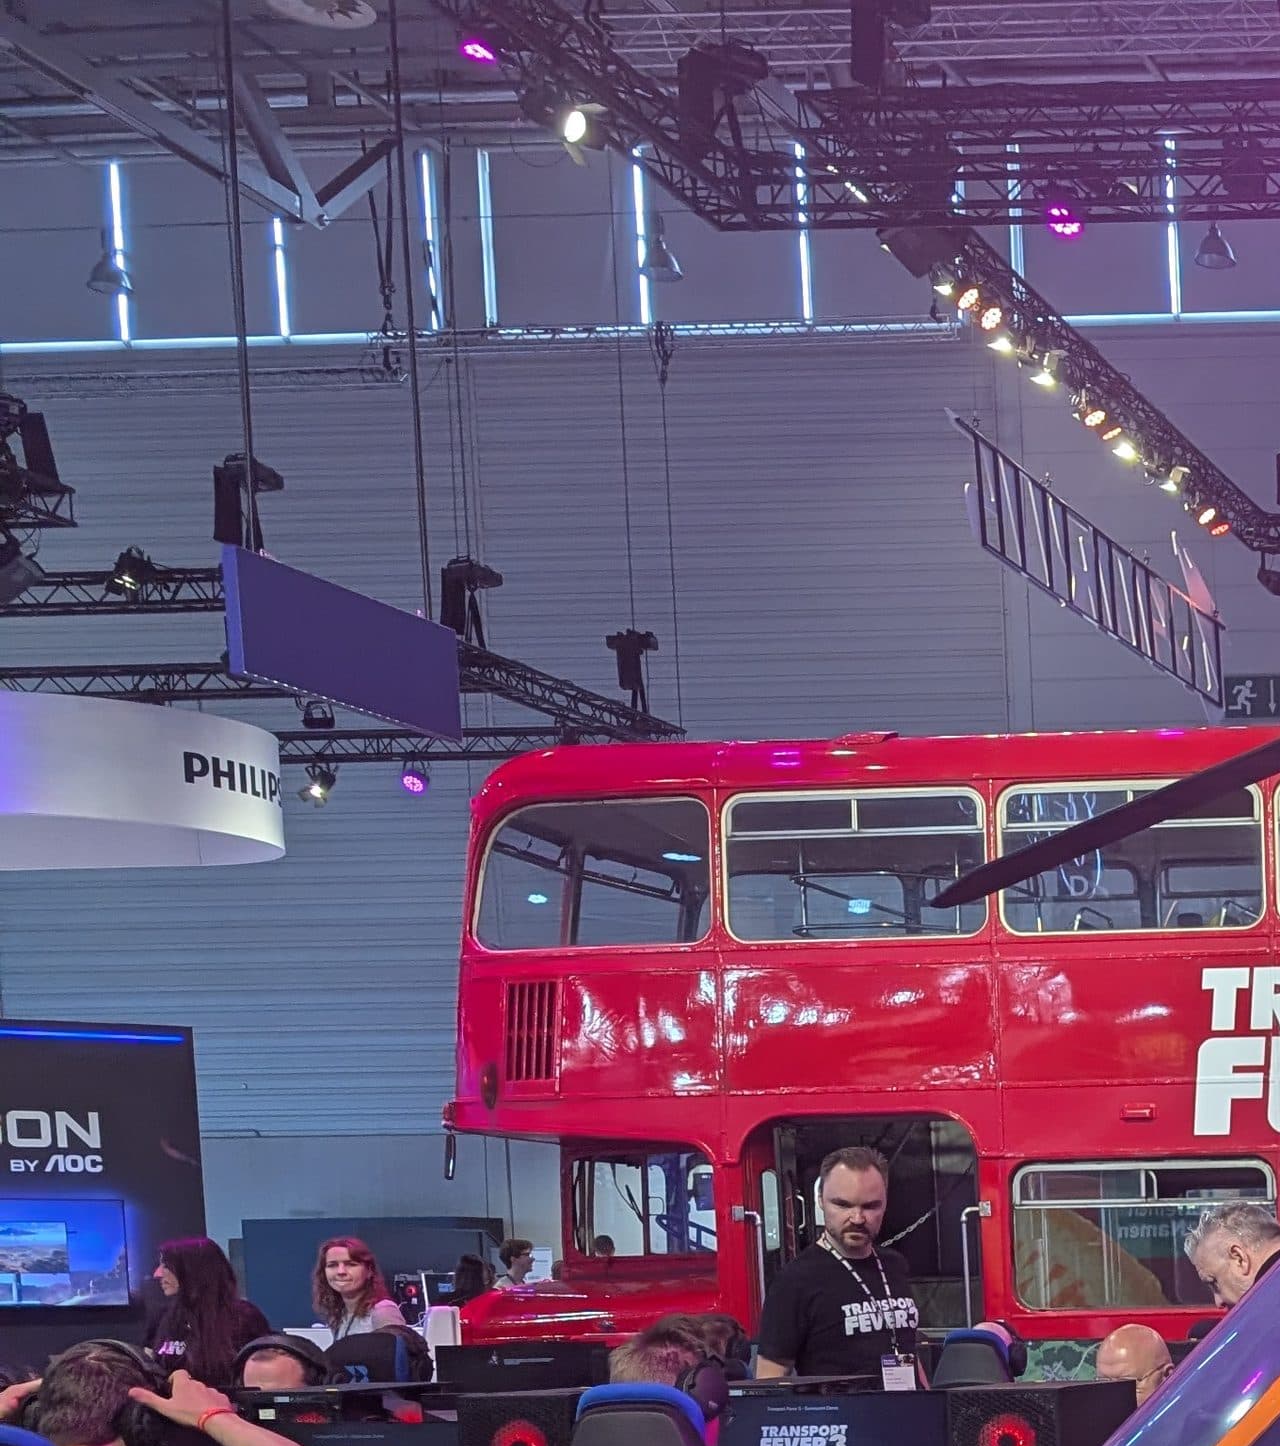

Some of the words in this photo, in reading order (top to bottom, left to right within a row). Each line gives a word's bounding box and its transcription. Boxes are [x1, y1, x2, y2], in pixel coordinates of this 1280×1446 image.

[0, 1110, 101, 1148] ON
[10, 1159, 39, 1172] BY
[45, 1154, 103, 1172] AOC
[761, 1425, 848, 1437] TRANSPORT
